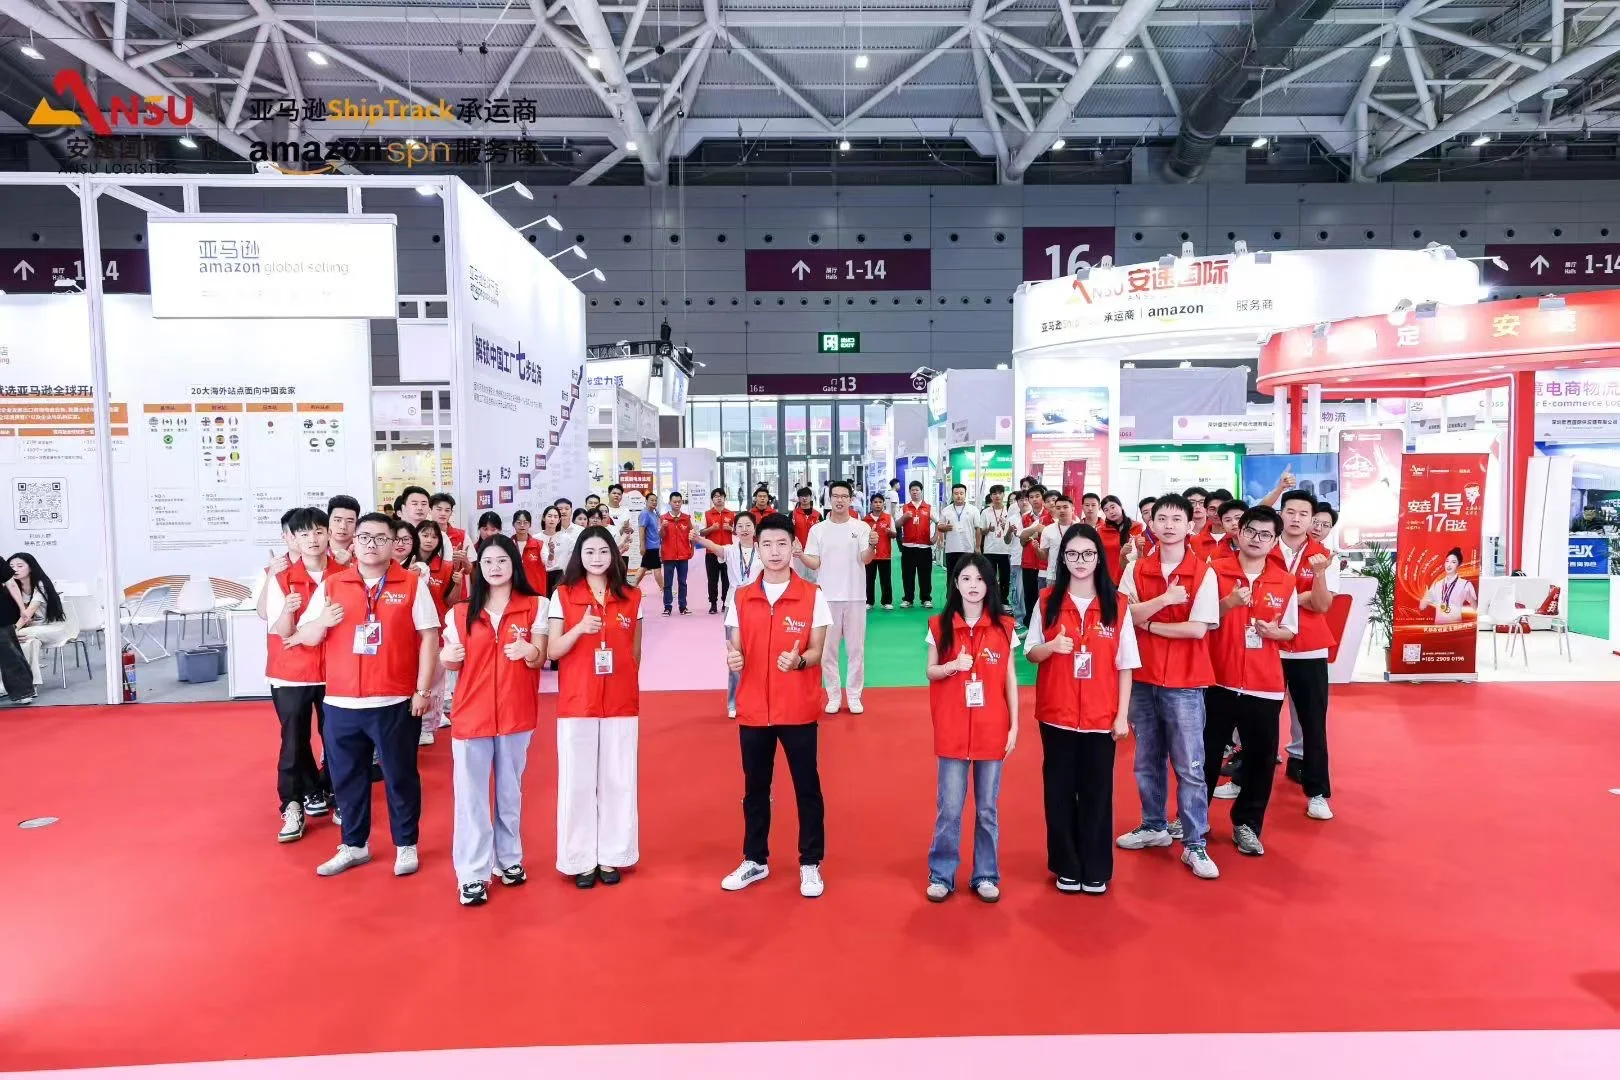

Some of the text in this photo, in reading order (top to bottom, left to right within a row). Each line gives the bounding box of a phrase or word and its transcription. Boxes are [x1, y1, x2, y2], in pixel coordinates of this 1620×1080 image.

[198, 240, 260, 259] 亚马逊
[199, 261, 261, 273] amazon
[845, 260, 887, 280] 1-14
[1045, 244, 1092, 280] 16
[1104, 299, 1274, 323] 承运商 amazon 服务商
[191, 386, 297, 396] 20大海外站点面向中国卖家
[822, 377, 857, 393] Gate 13
[1322, 411, 1347, 422] 物流
[1425, 513, 1468, 532] 17日达
